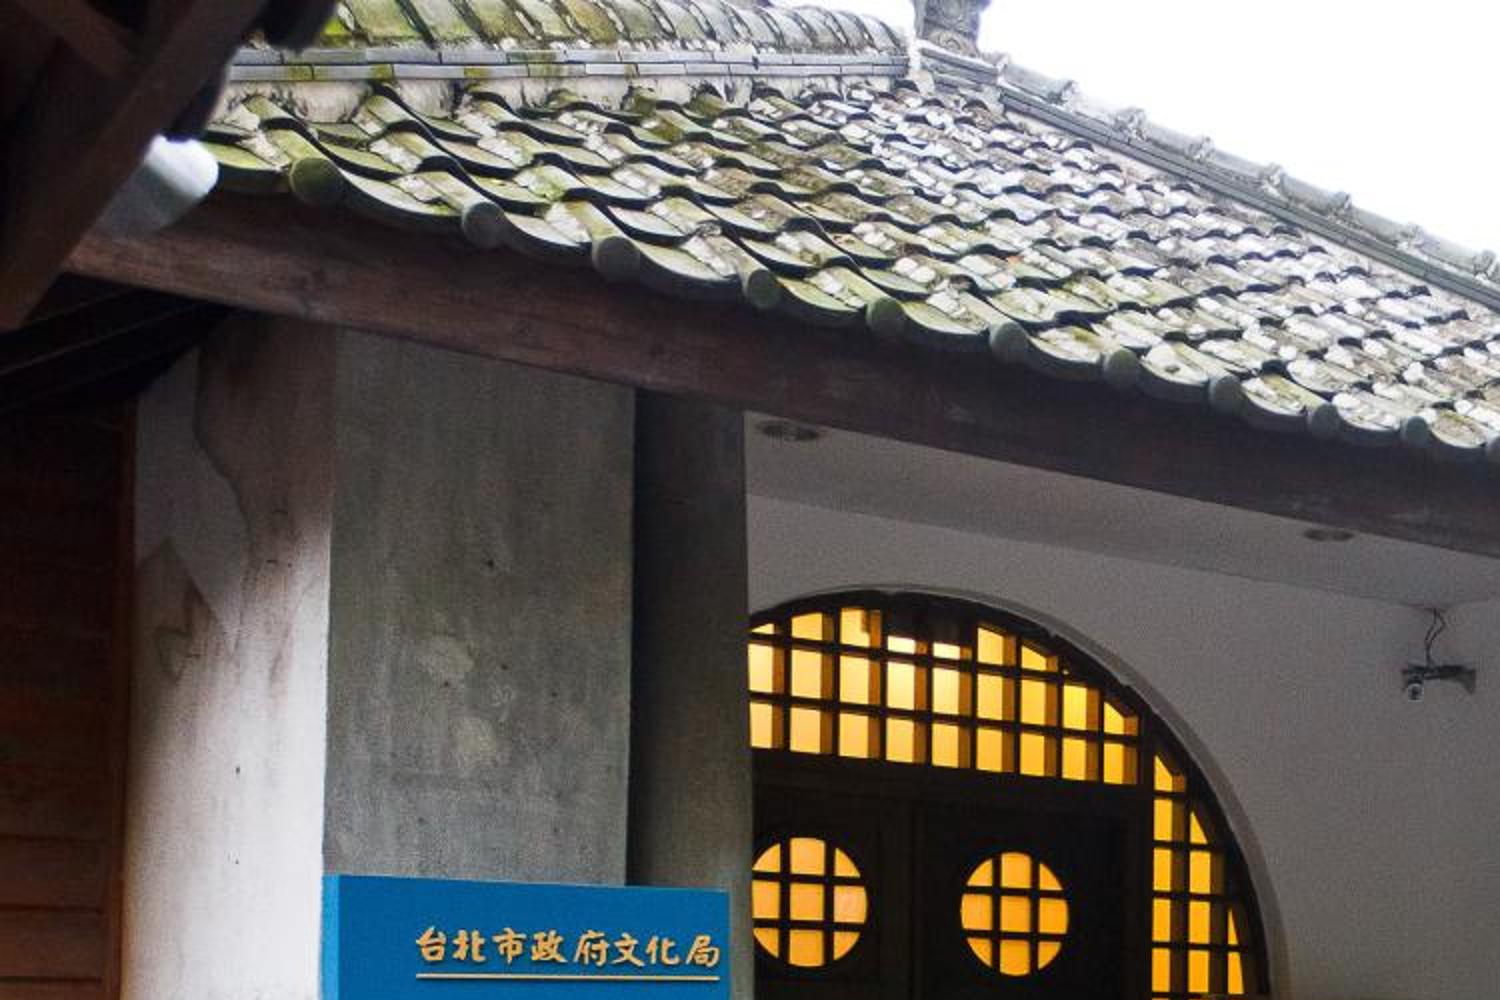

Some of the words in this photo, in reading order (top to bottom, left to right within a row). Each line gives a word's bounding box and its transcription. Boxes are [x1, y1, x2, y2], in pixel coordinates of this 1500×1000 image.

[415, 926, 720, 968] 台北市政府文化局
